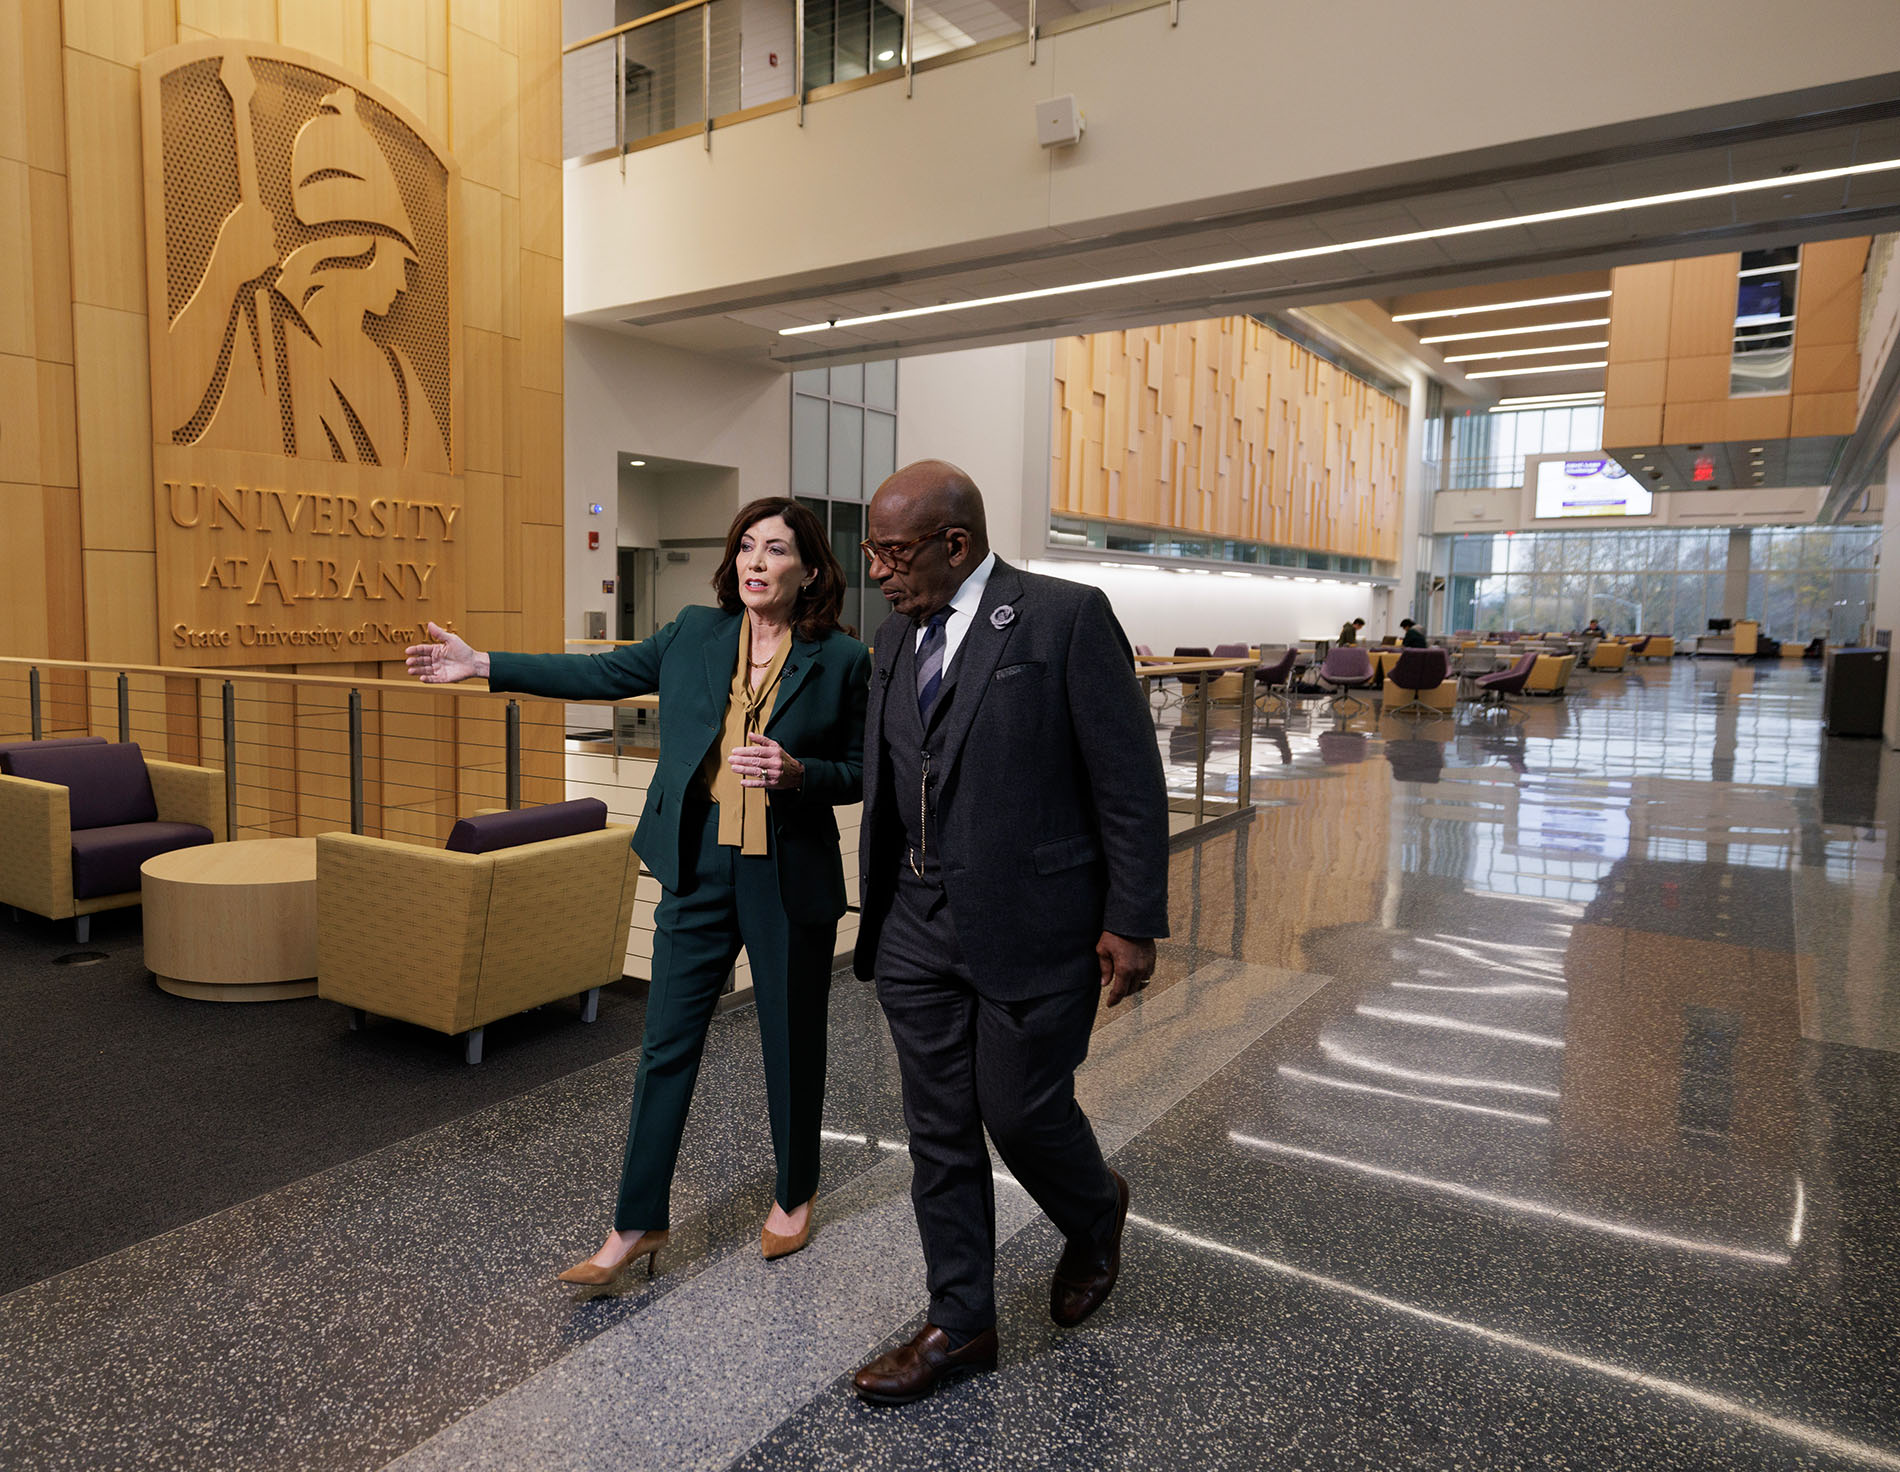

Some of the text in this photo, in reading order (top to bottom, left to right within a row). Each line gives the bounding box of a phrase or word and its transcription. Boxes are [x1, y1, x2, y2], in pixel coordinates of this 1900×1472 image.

[164, 480, 461, 543] UNIVERSITY
[200, 548, 437, 606] AT ALBANY
[173, 623, 233, 650] State
[236, 624, 345, 652] University
[348, 621, 369, 646] of
[371, 623, 415, 646] New
